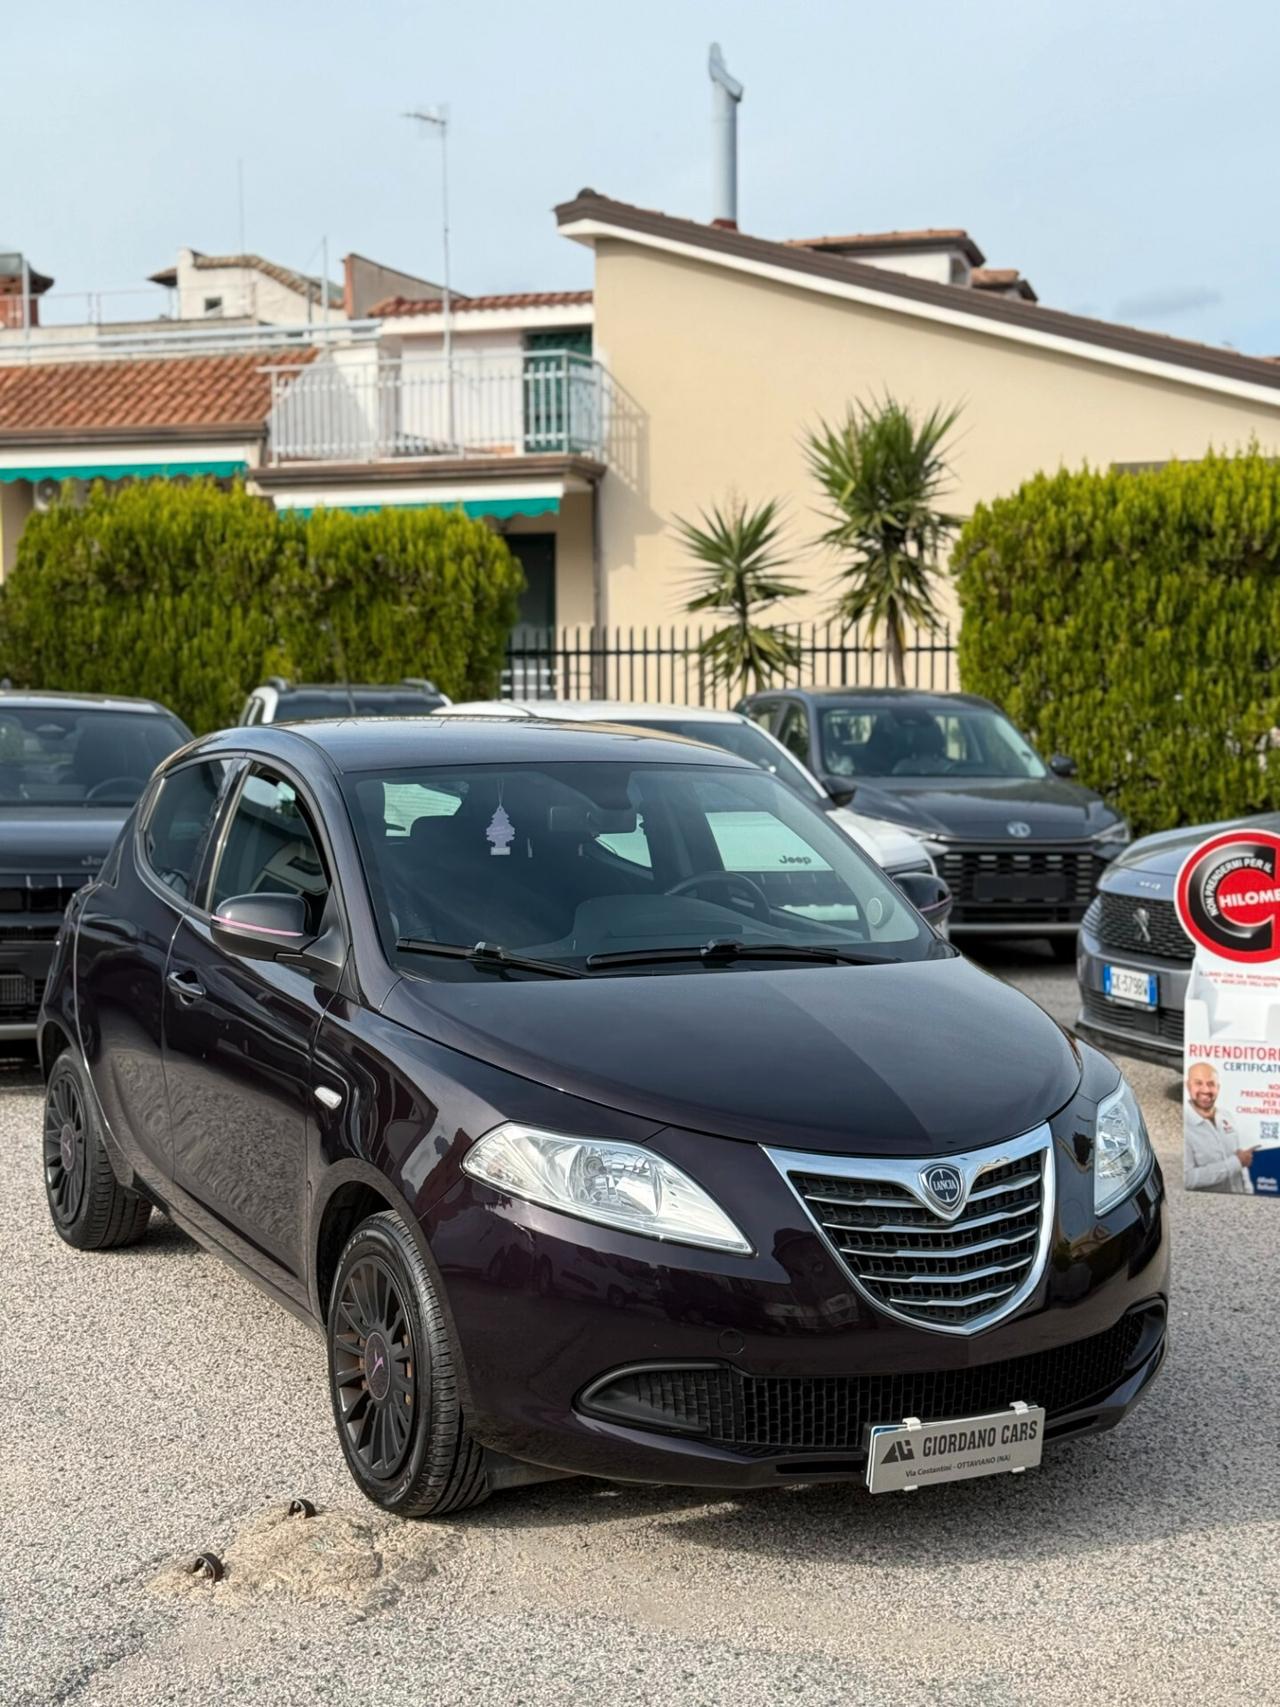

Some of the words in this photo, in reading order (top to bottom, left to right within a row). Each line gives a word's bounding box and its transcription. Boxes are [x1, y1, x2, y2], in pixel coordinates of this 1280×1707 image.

[779, 855, 812, 865] Jeep
[1244, 858, 1264, 869] PER
[1205, 859, 1242, 896] PRENDERMI
[1205, 897, 1219, 917] NON
[932, 1179, 957, 1192] LANCIA
[922, 1427, 997, 1458] GIORDANO
[1001, 1420, 1038, 1445] CARS
[905, 1467, 916, 1477] Via
[917, 1464, 952, 1476] Costantini
[957, 1456, 996, 1470] OTTAVIANO
[996, 1454, 1011, 1464] (NA)
